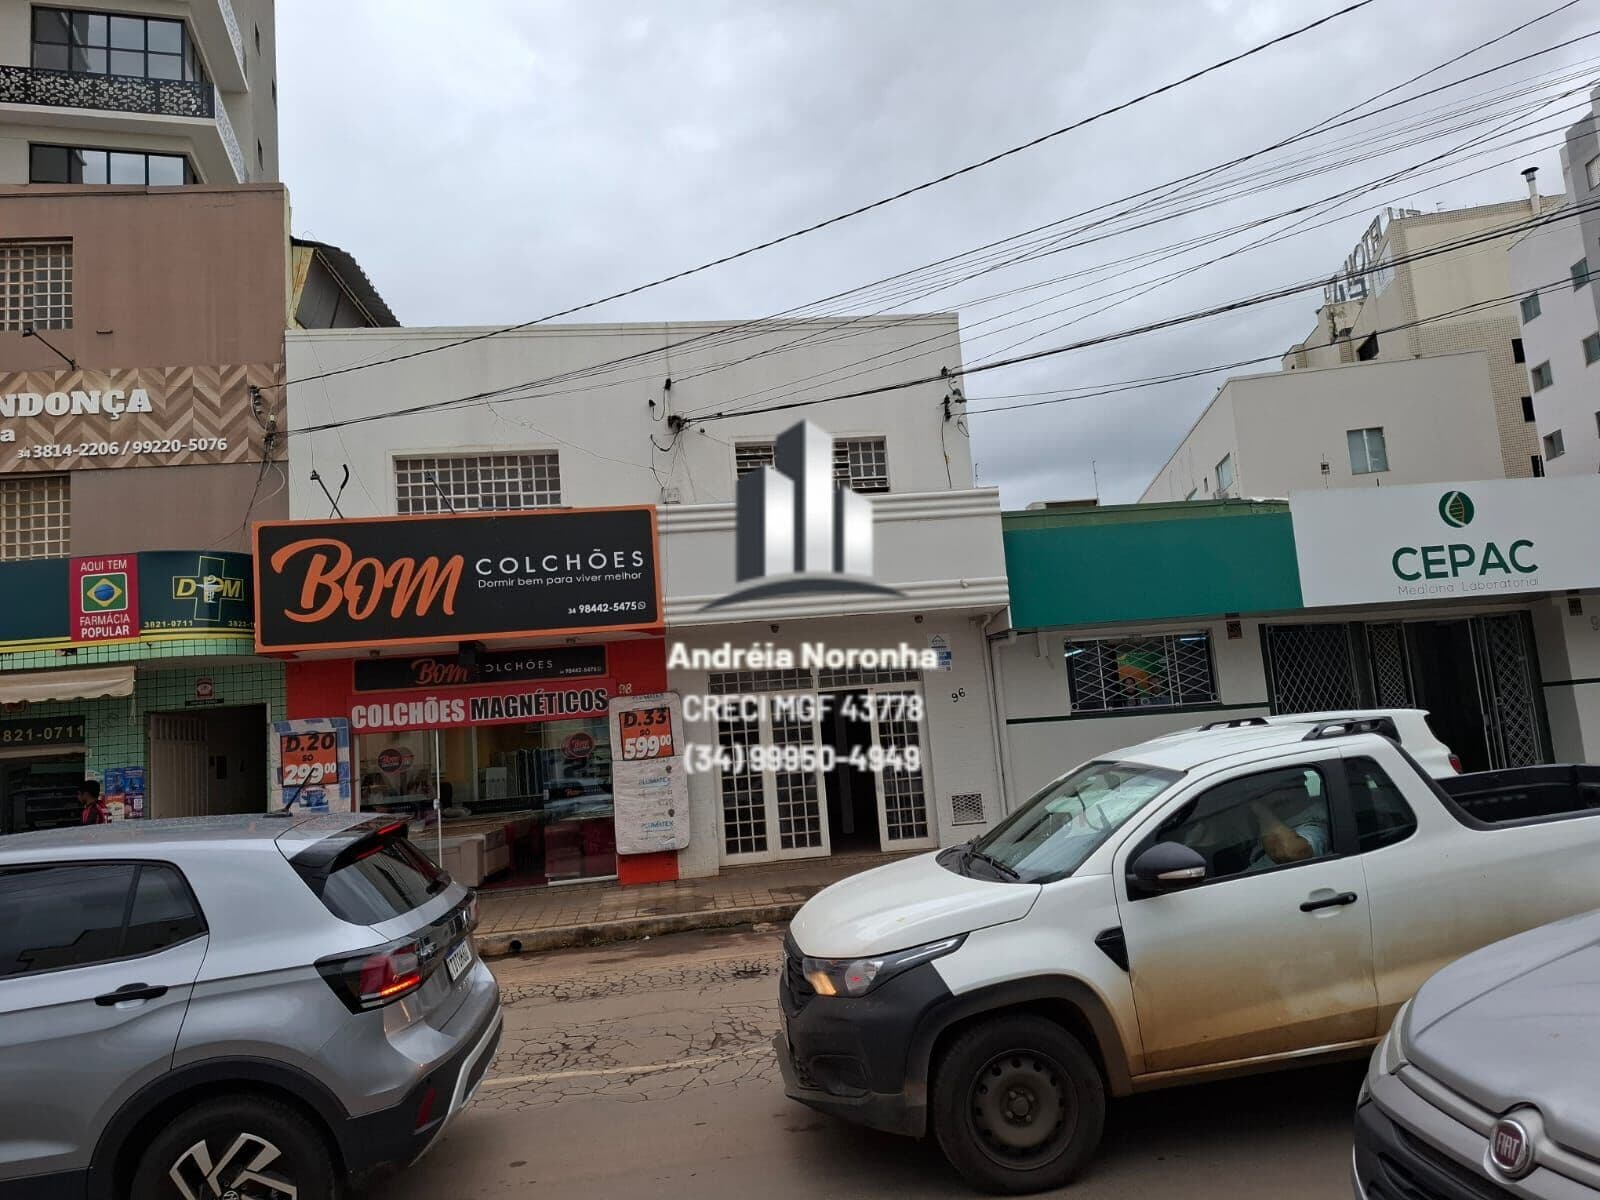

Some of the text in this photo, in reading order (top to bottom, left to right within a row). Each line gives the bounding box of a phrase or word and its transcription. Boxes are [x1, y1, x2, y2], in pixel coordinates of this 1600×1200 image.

[33, 442, 119, 459] 3814-2206
[132, 437, 228, 455] 99220-5076
[80, 559, 127, 572] AQUI TEM
[475, 548, 644, 576] COLCHÕES
[1392, 539, 1538, 582] CEPAC
[478, 570, 642, 589] Dormir bem para viver melhor
[1398, 577, 1539, 596] Medicina Laboratorial
[578, 600, 638, 615] 98442-5475
[80, 613, 130, 627] FARMÁCIA
[81, 625, 130, 639] POPULAR
[951, 687, 966, 703] 96
[351, 687, 609, 729] COLCHÕES MAGNÉTICOS
[3, 725, 84, 743] 821-0711
[285, 733, 335, 753] D.20
[1496, 1131, 1520, 1161] FIAT
